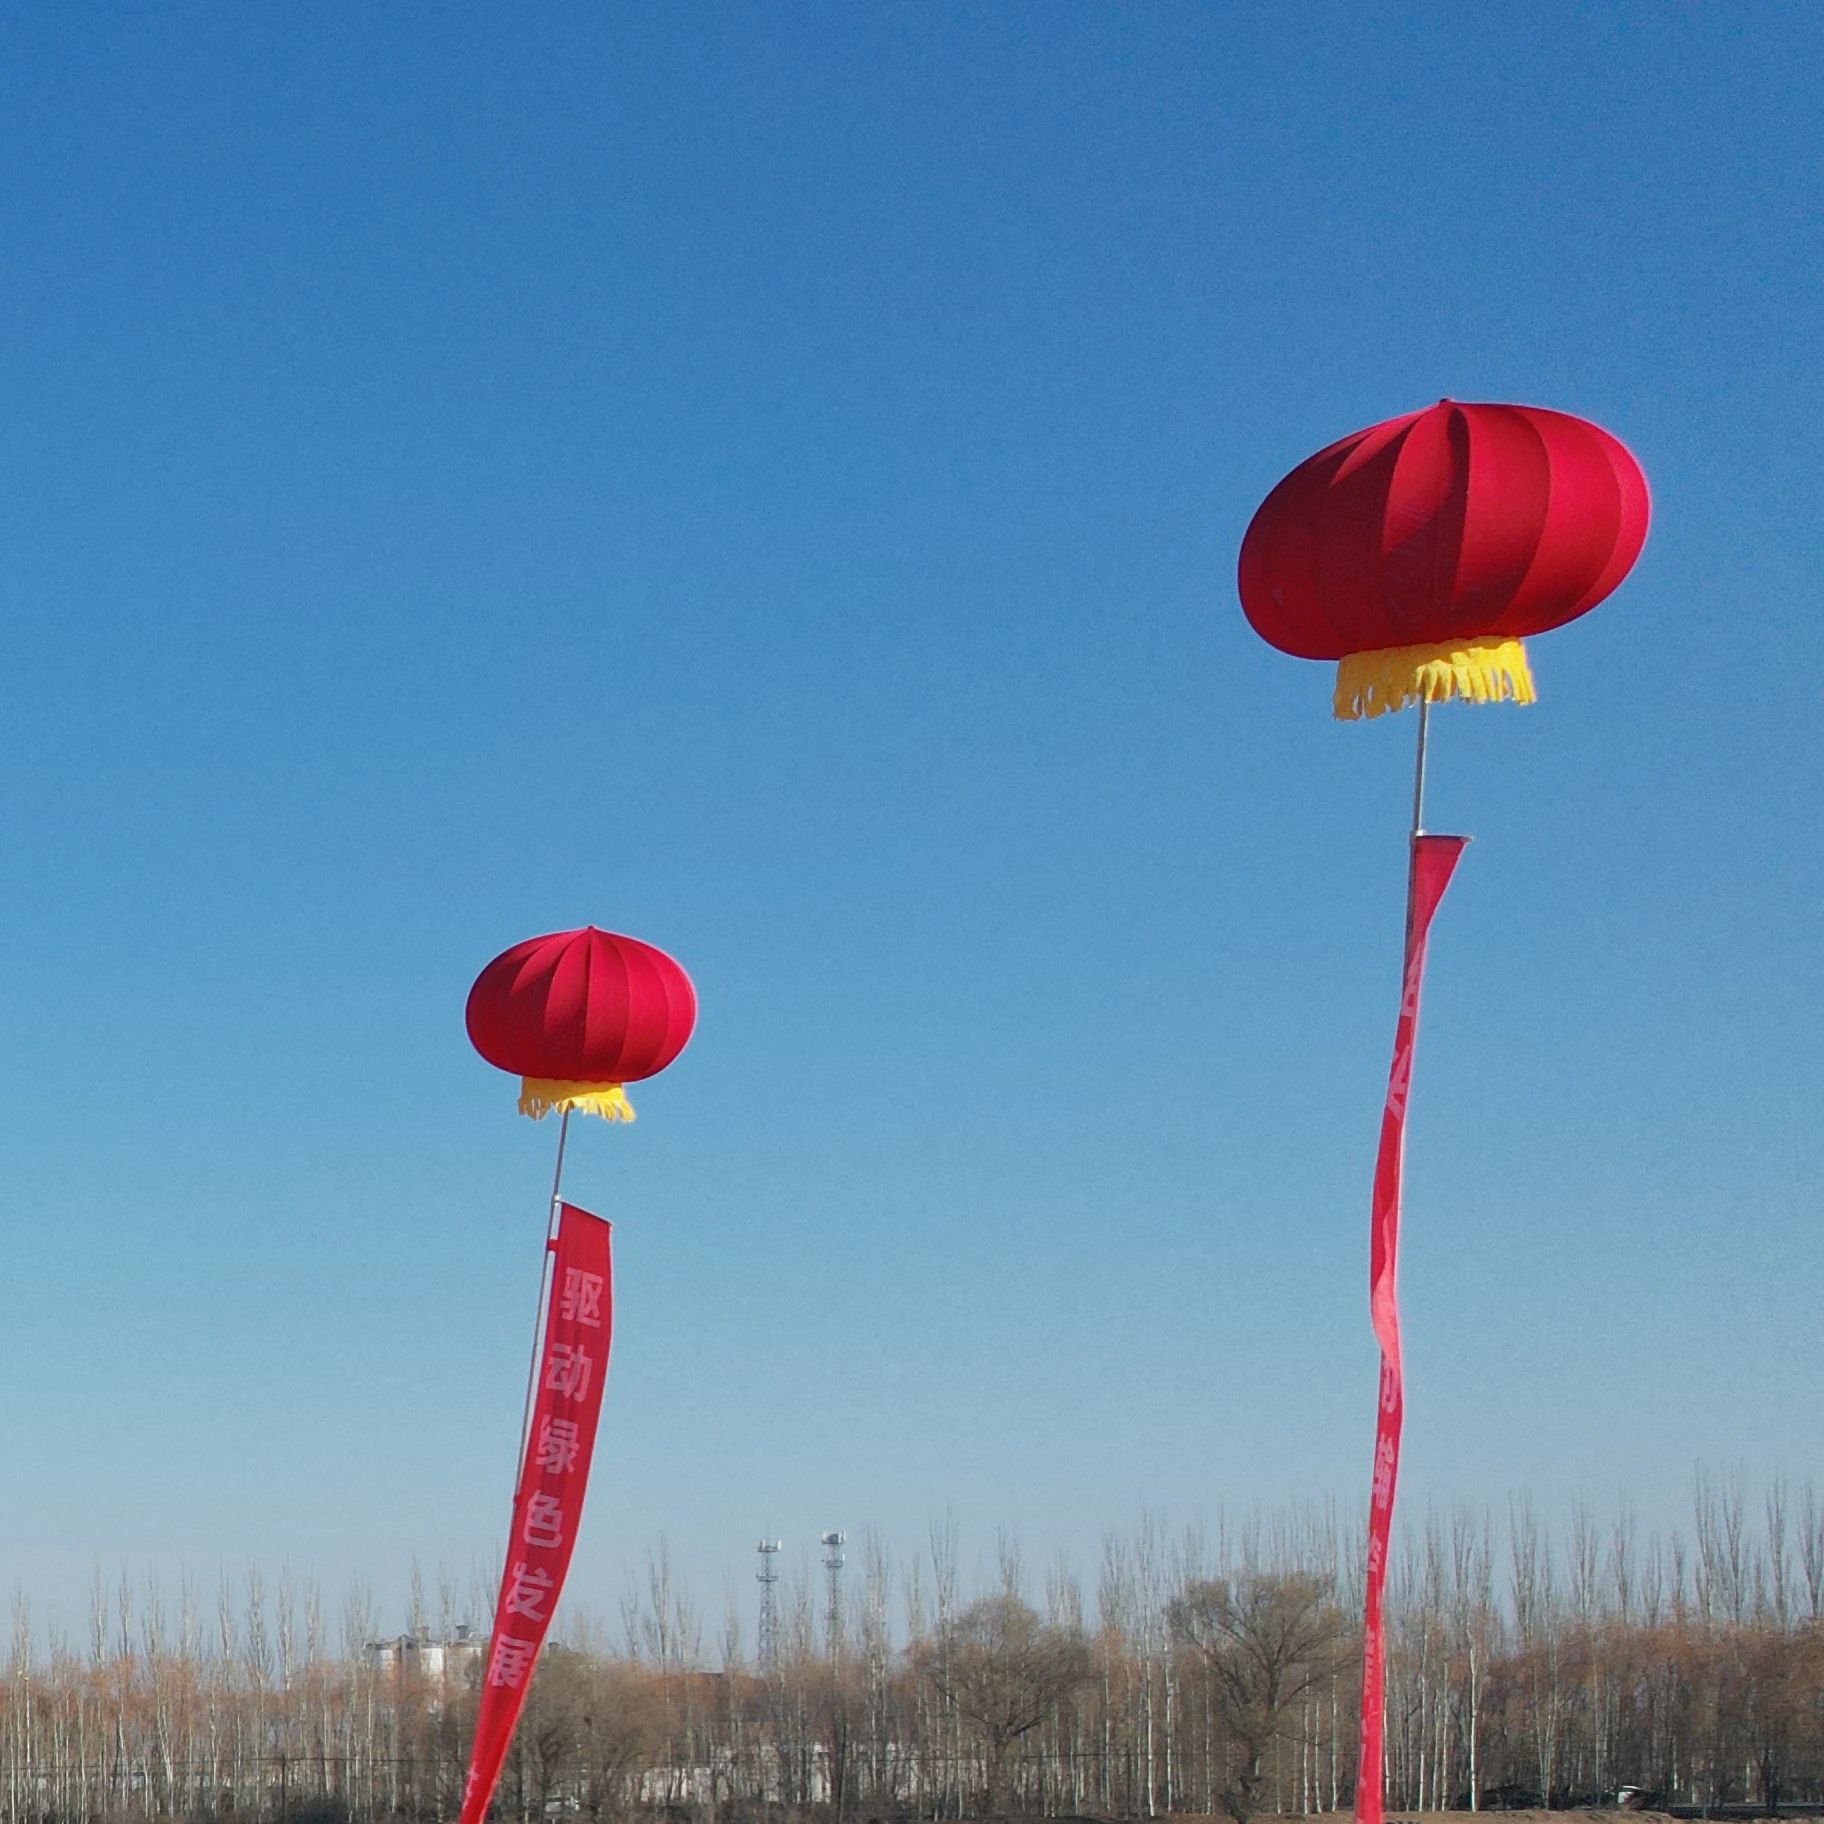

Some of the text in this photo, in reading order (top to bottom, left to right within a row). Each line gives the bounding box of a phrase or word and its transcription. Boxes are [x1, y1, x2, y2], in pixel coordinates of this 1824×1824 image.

[488, 1267, 603, 1690] 驱动绿色发展
